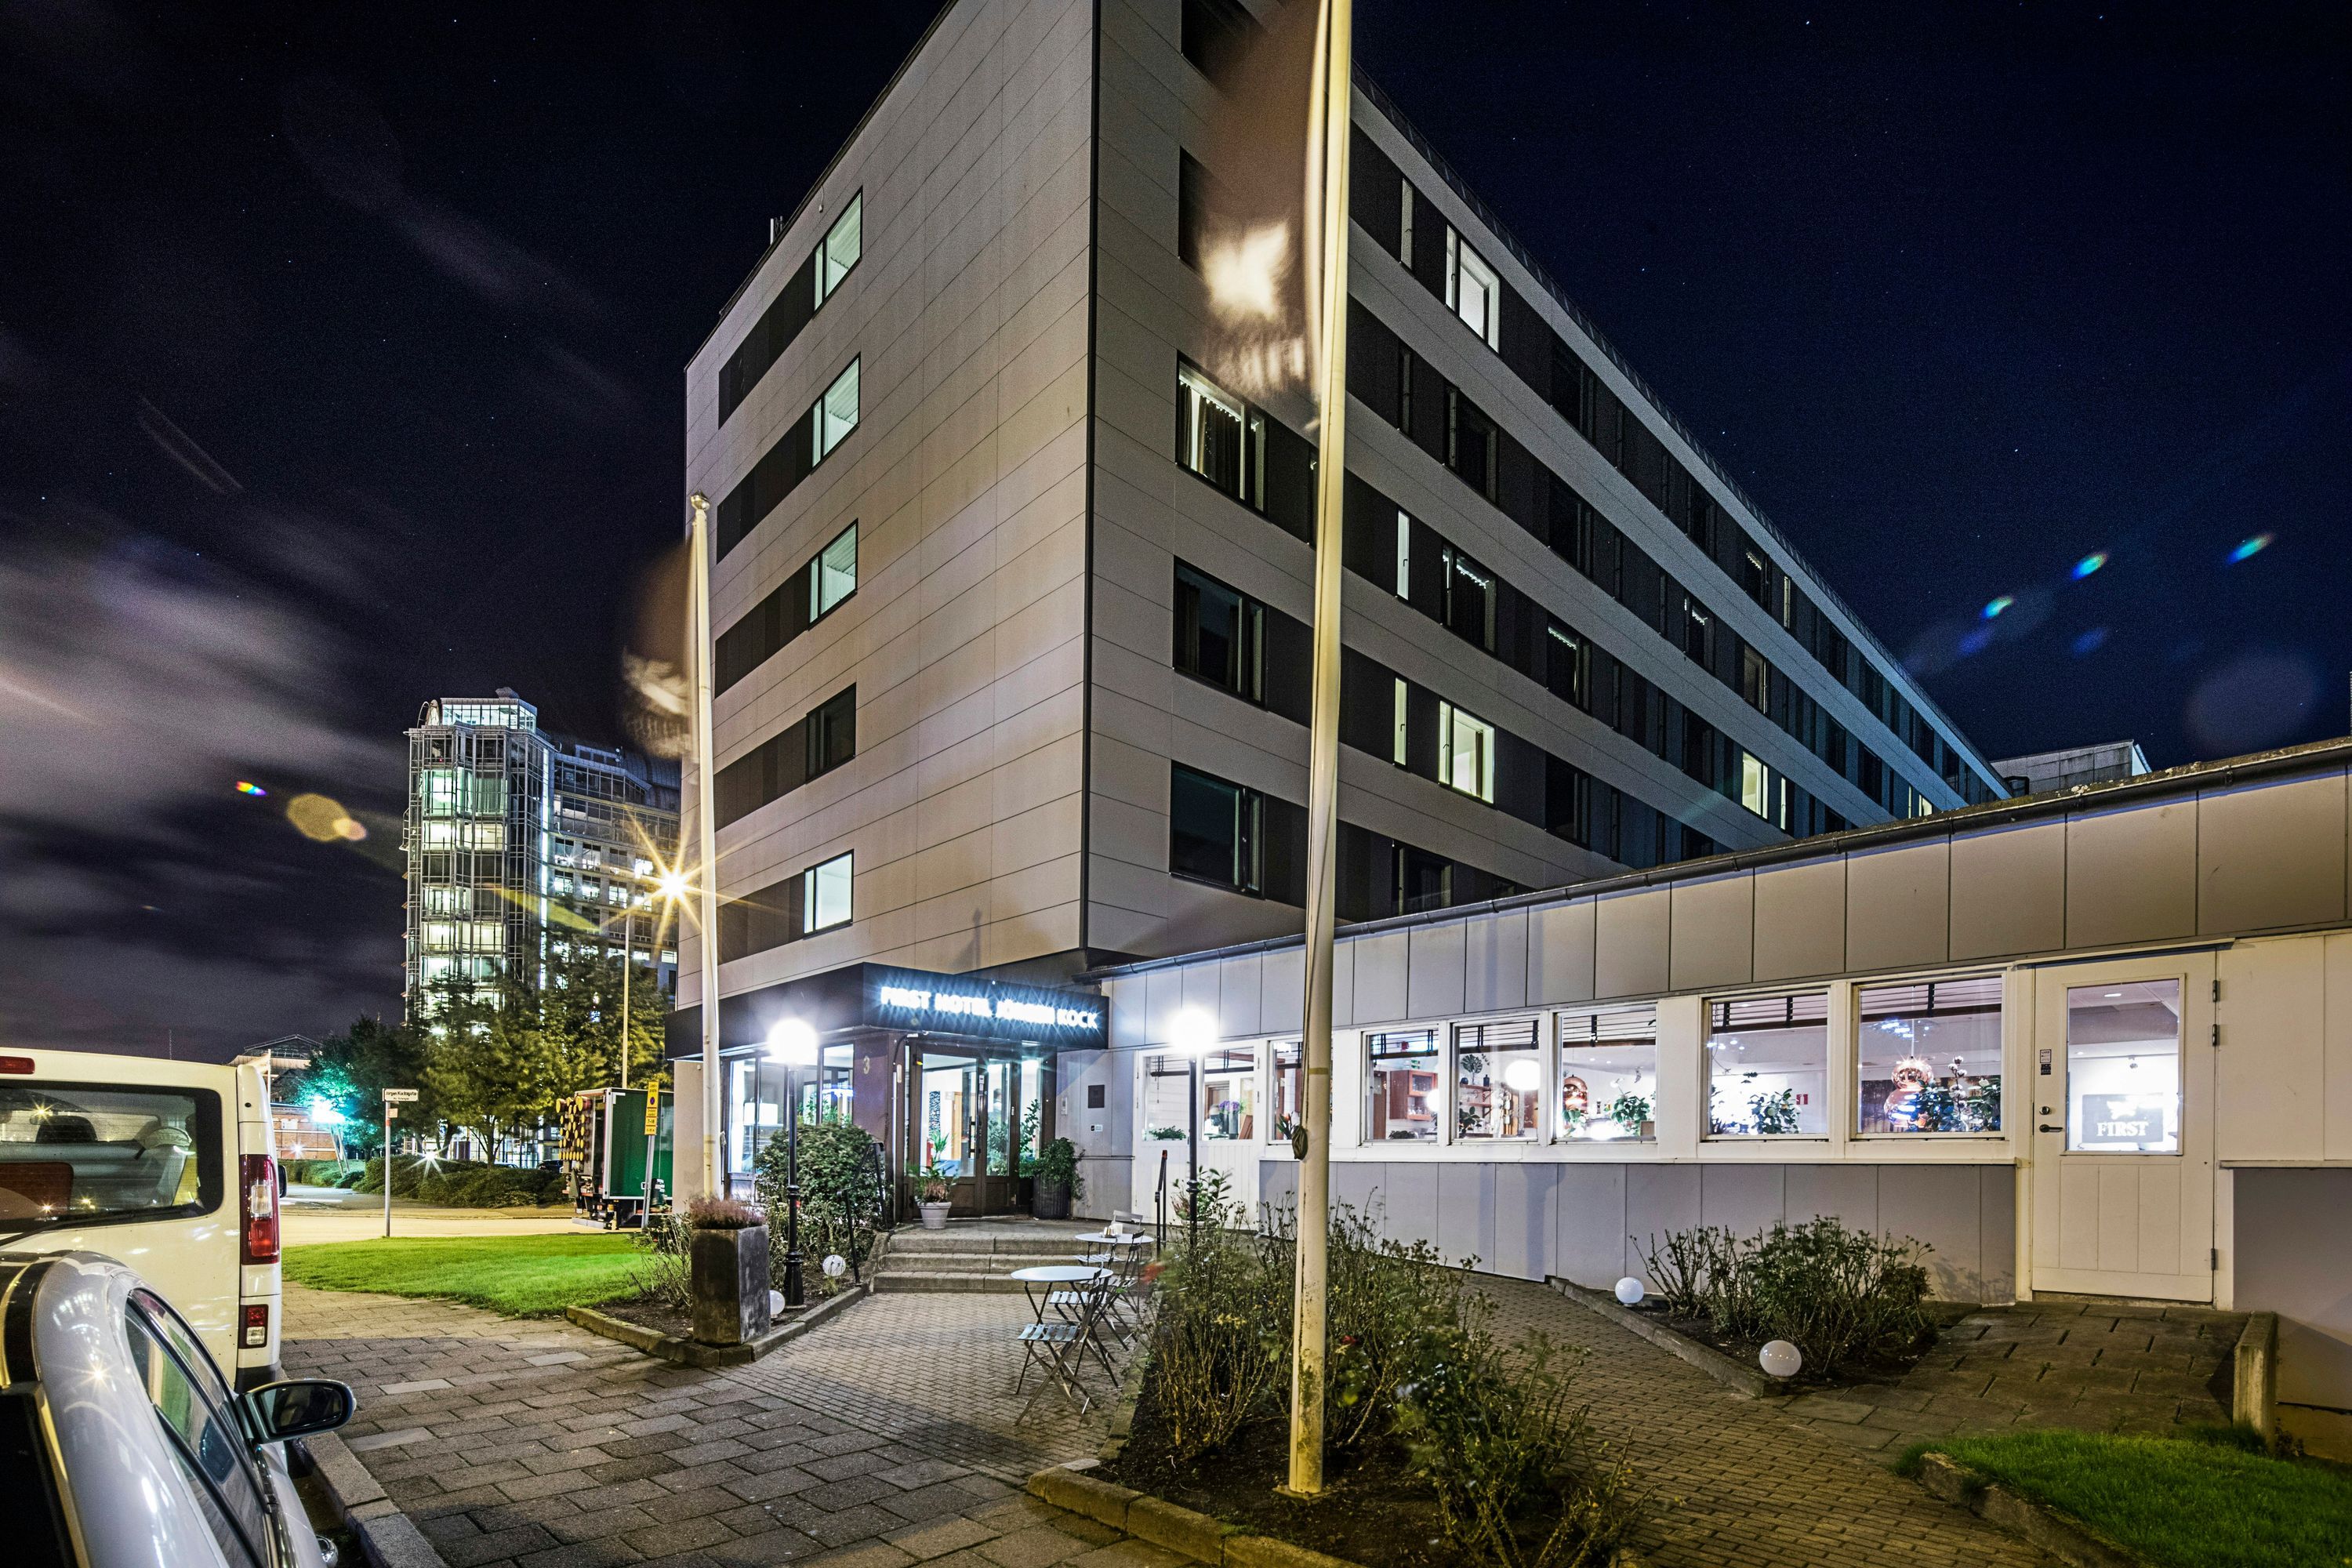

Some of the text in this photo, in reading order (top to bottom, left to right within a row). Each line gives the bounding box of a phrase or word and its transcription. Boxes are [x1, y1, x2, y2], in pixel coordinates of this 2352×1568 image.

[1057, 1008, 1098, 1029] KOCK
[863, 1055, 870, 1074] 3
[2096, 1121, 2149, 1137] FIRST
